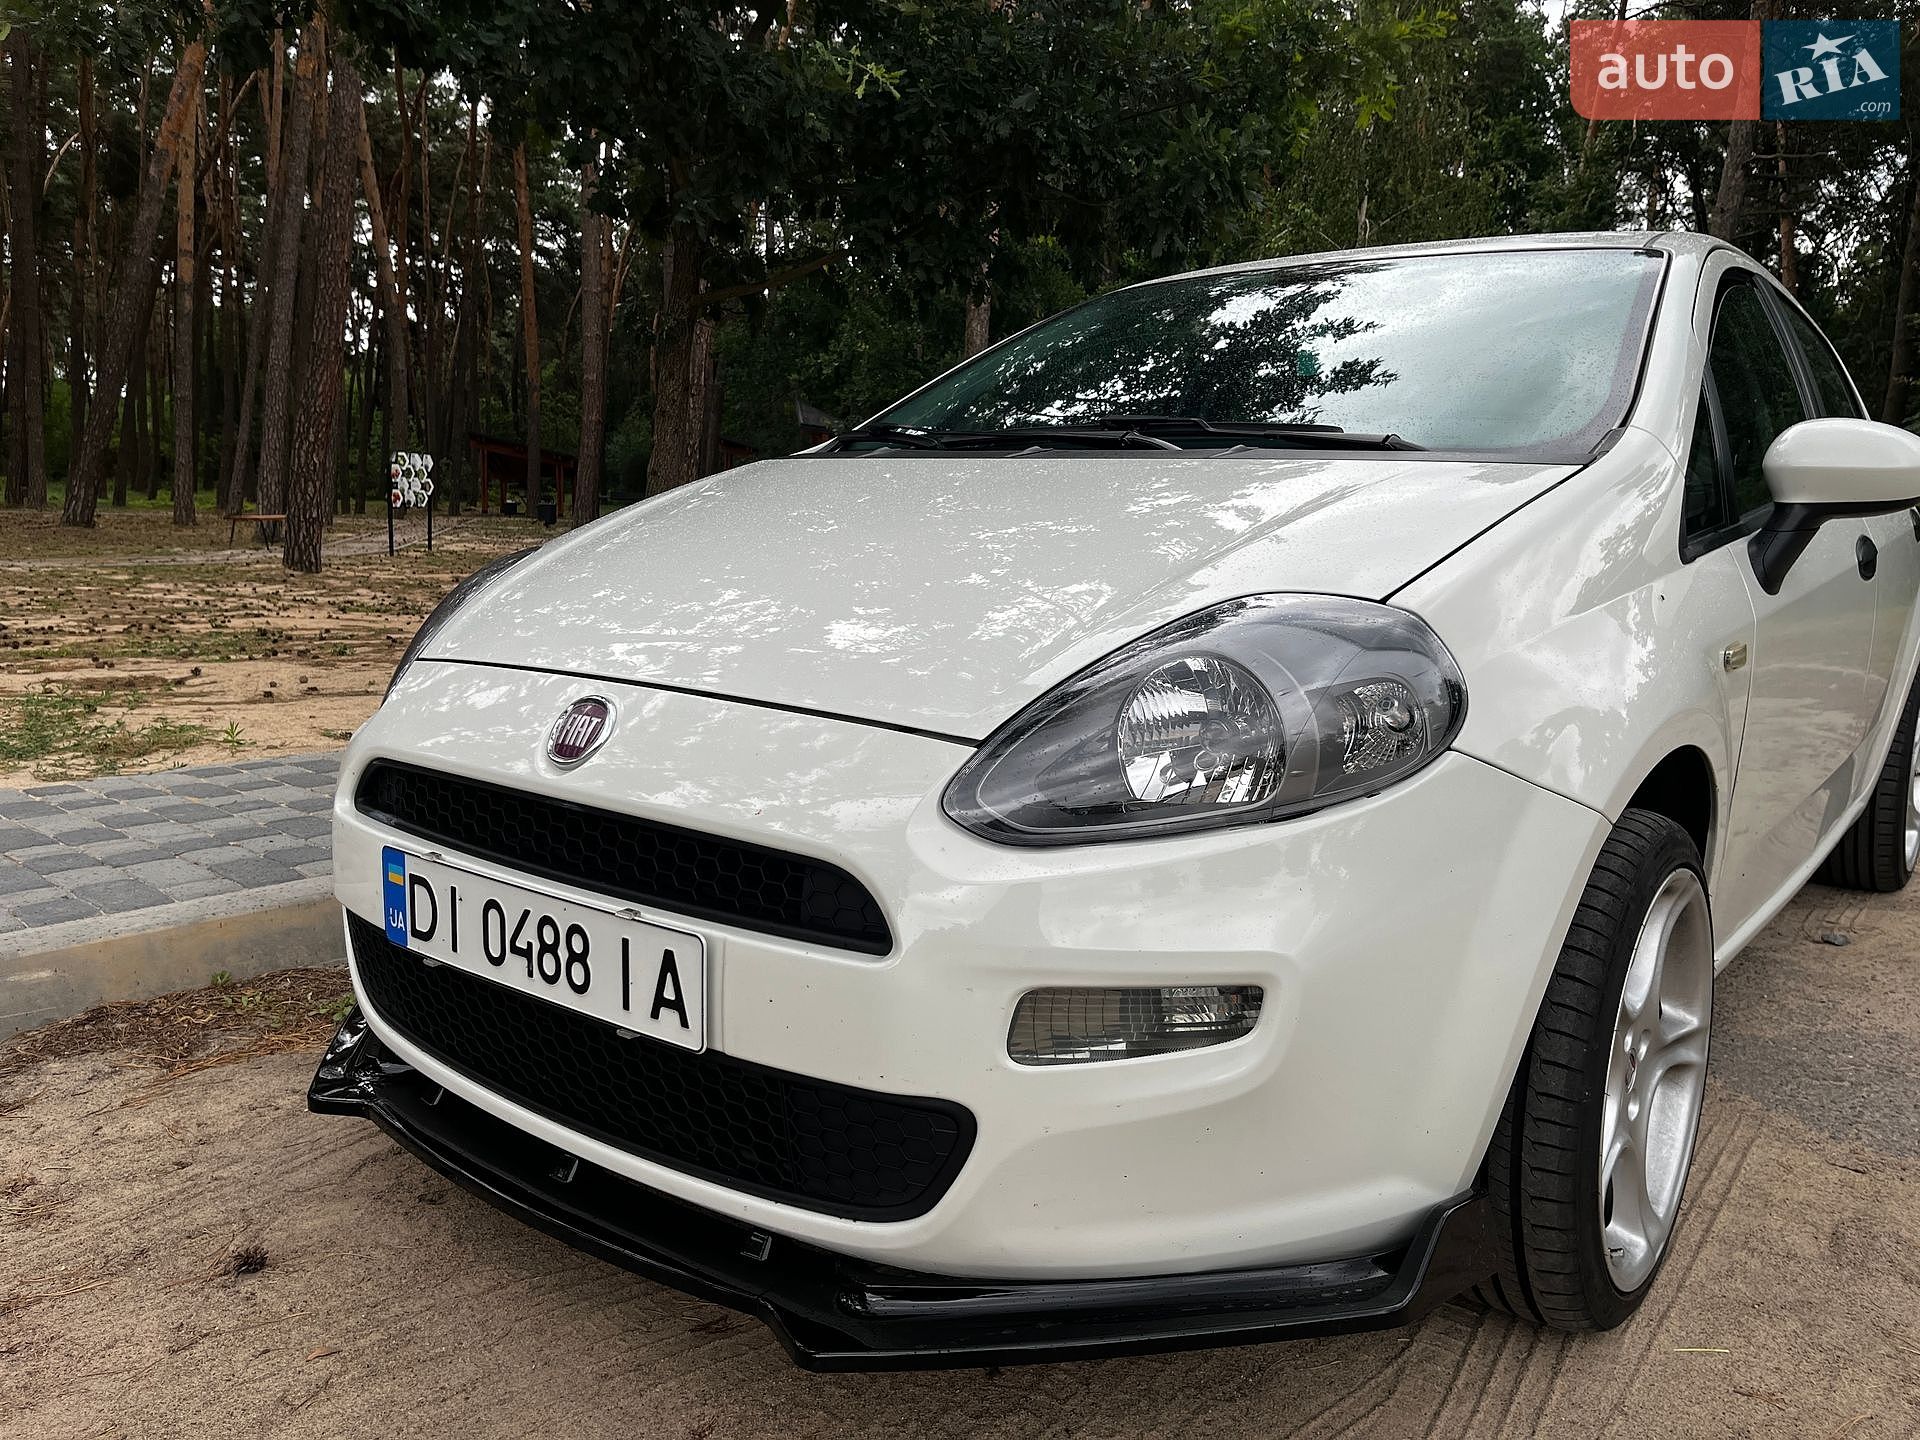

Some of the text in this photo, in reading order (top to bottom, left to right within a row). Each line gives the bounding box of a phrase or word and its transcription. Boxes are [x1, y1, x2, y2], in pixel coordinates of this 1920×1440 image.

[558, 713, 602, 748] FIAT
[389, 907, 406, 931] UA
[409, 873, 690, 1029] DI 0488 IA
